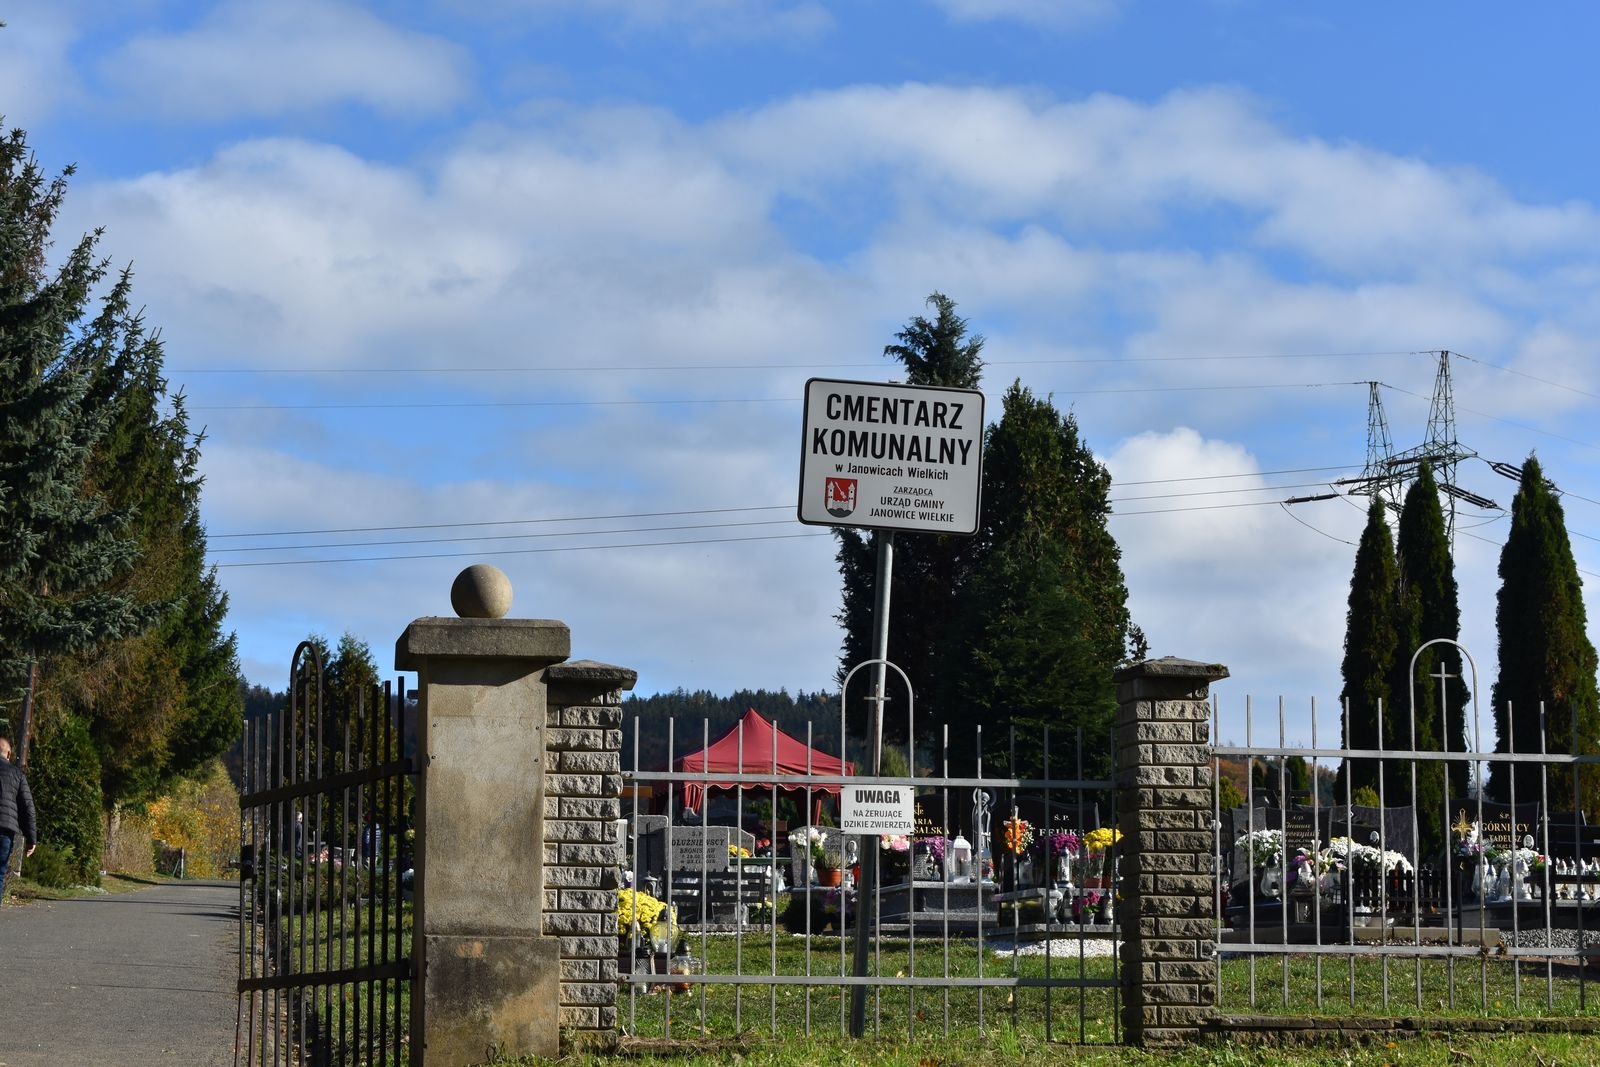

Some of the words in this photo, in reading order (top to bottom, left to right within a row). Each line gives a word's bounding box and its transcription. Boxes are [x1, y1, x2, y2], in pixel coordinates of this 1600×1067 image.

[826, 393, 964, 430] CMENTARZ
[812, 427, 973, 466] KOMUNALNY
[835, 463, 843, 472] w
[847, 462, 903, 477] Janowicach
[907, 466, 949, 481] Wielkich
[893, 485, 933, 496] ZARZĄDCA
[880, 496, 911, 509] URZĄD
[914, 498, 945, 509] GMINY
[869, 508, 916, 519] JANOWICE
[917, 511, 955, 522] WIELKIE
[855, 789, 901, 804] UWAGA
[853, 809, 864, 817] NA
[864, 807, 903, 819] ŻERUJĄCE
[844, 820, 869, 828] DZIKIE
[870, 821, 911, 830] ZWIERZĘTA
[1481, 820, 1530, 832] GÓRNICY
